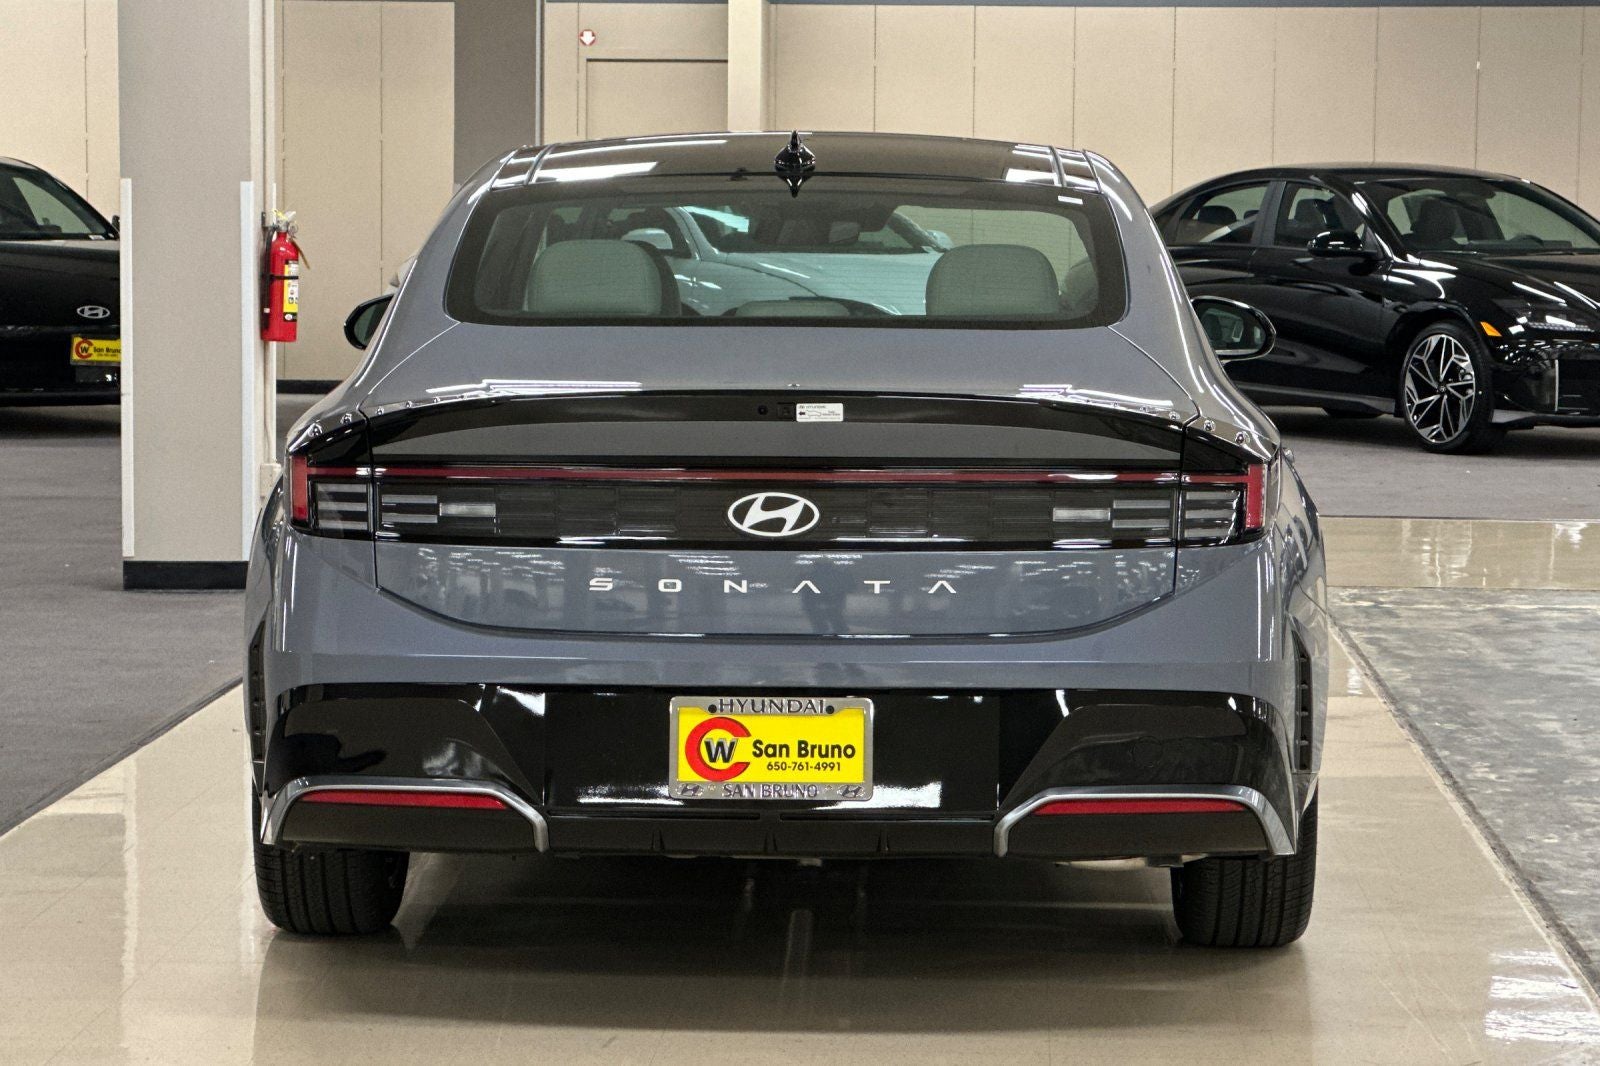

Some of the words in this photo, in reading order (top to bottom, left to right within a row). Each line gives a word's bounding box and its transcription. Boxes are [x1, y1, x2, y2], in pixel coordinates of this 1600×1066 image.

[588, 577, 957, 594] SONATA
[718, 698, 825, 714] HYUNDAI
[752, 739, 791, 759] San
[797, 739, 856, 759] Bruno
[766, 761, 841, 772] 650-761-4991
[723, 784, 754, 798] SAN
[760, 784, 818, 798] BRUNO
